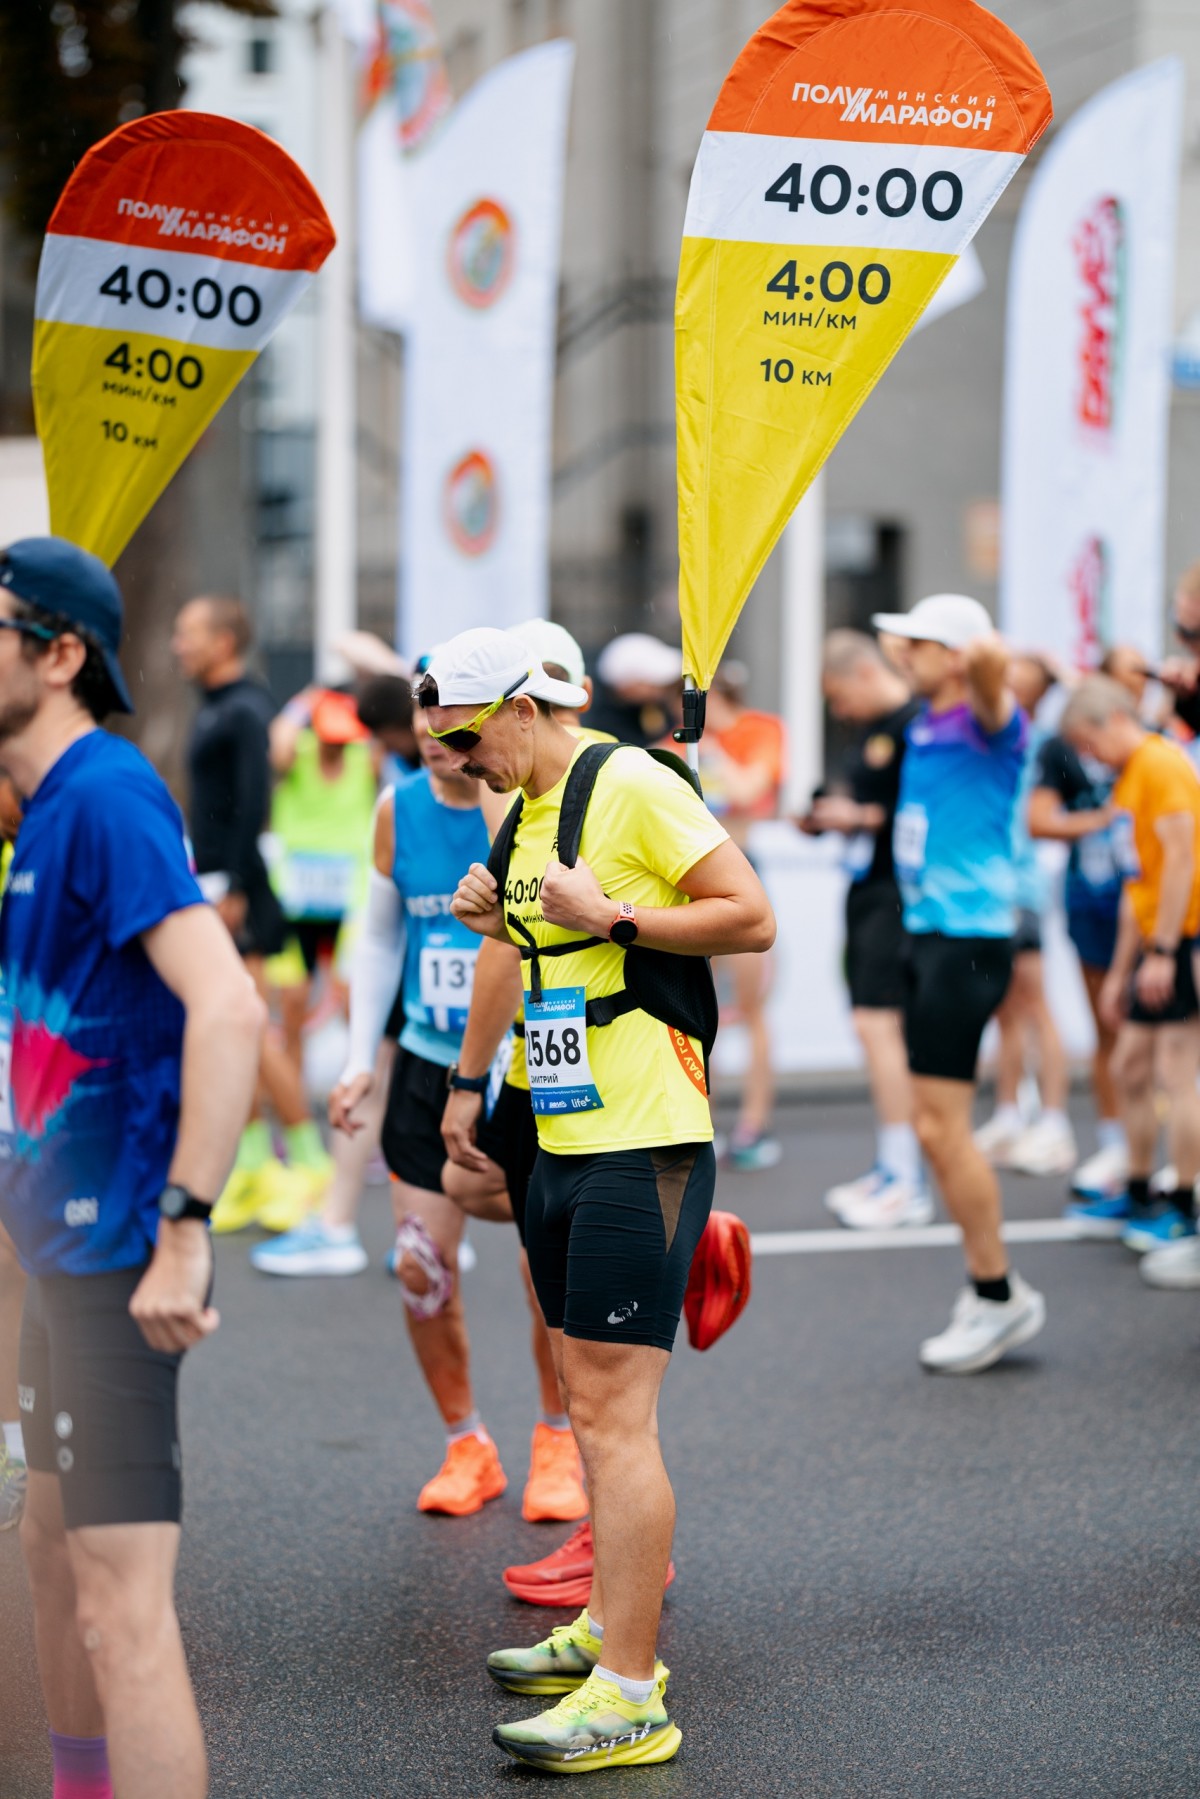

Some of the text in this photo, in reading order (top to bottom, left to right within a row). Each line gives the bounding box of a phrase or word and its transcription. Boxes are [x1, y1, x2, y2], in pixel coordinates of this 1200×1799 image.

[875, 89, 996, 108] МИНСКИЙ
[842, 102, 993, 131] МАРАФОН
[764, 162, 963, 221] 40:00
[99, 264, 261, 327] 40:00
[766, 259, 892, 305] 4:00
[103, 342, 205, 390] 4:00
[760, 358, 794, 384] 10
[102, 420, 129, 443] 10
[504, 876, 545, 905] 40:0
[431, 959, 475, 989] 13
[674, 1029, 688, 1054] ГОР
